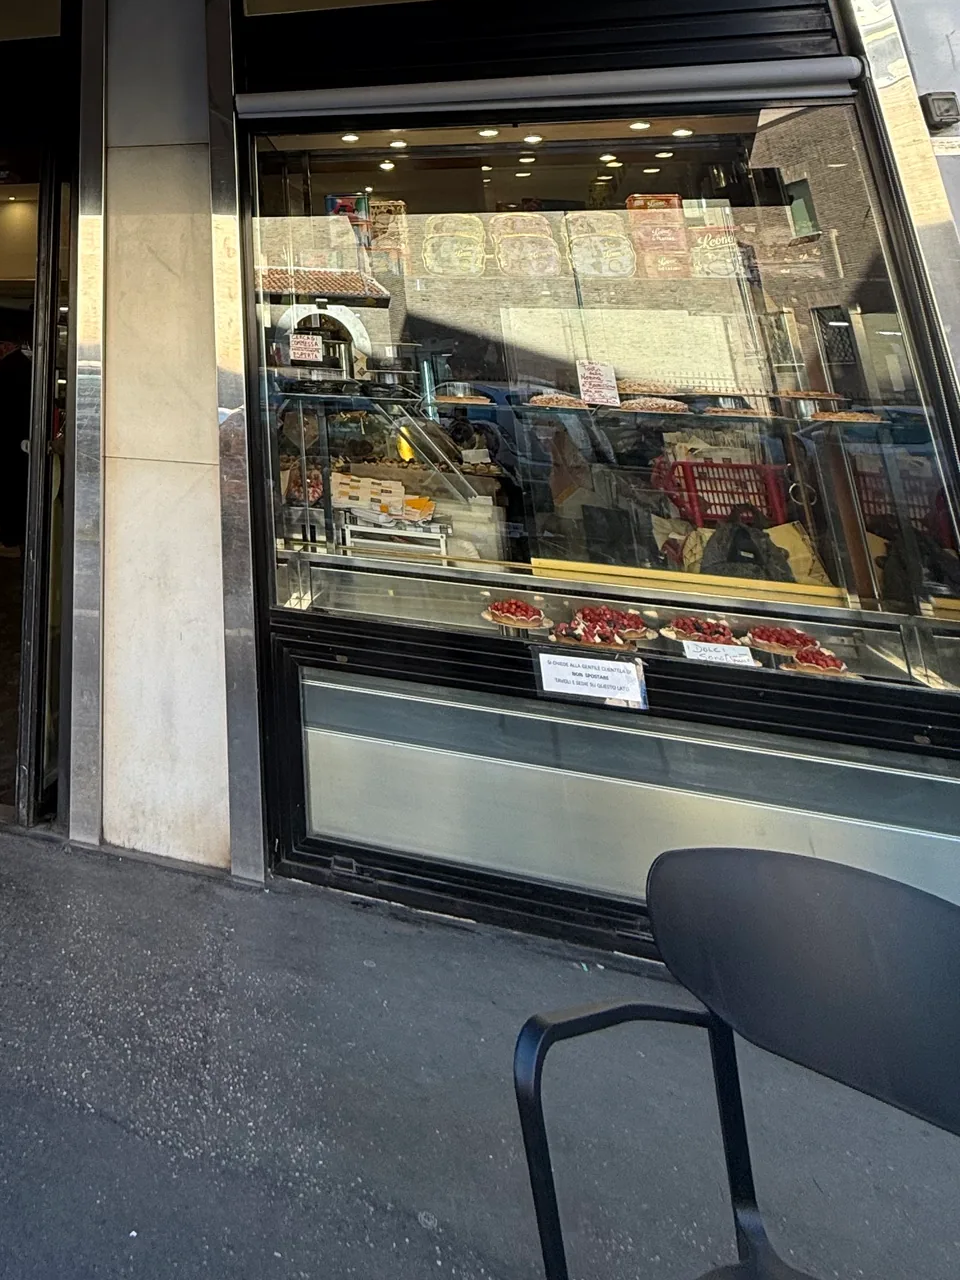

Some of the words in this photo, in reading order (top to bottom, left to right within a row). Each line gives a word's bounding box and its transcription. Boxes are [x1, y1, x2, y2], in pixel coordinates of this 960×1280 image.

[697, 233, 736, 249] Leone
[692, 644, 726, 653] DOLCI
[584, 673, 609, 681] SPOSTARE
[554, 677, 571, 685] TAVOLI
[597, 683, 617, 691] QUESTO
